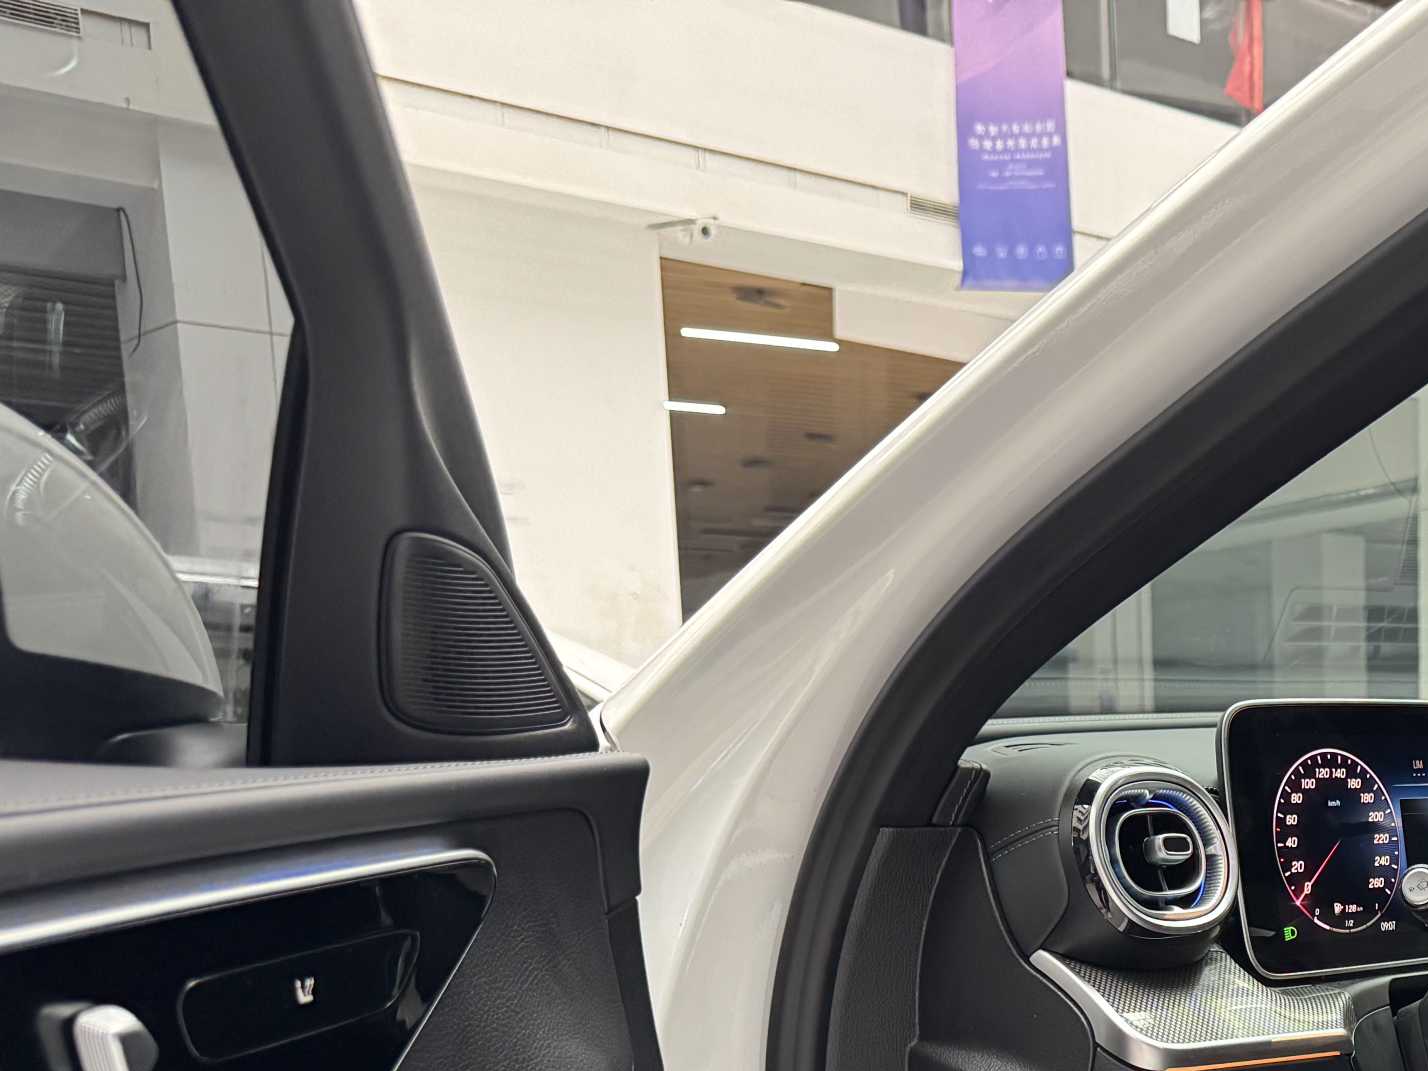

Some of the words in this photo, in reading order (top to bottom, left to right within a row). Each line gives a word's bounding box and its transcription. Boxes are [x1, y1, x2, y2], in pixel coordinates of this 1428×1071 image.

[1315, 768, 1330, 778] 120
[1332, 768, 1346, 778] 140
[1301, 778, 1316, 789] 100
[1347, 778, 1362, 789] 160
[1291, 793, 1303, 804] 80
[1360, 793, 1375, 803] 180
[1286, 814, 1298, 825] 60
[1368, 812, 1384, 822] 200
[1285, 837, 1298, 848] 40
[1373, 834, 1390, 844] 220
[1374, 856, 1390, 866] 240
[1291, 861, 1304, 872] 20
[1368, 878, 1385, 889] 260
[1345, 904, 1357, 913] 128
